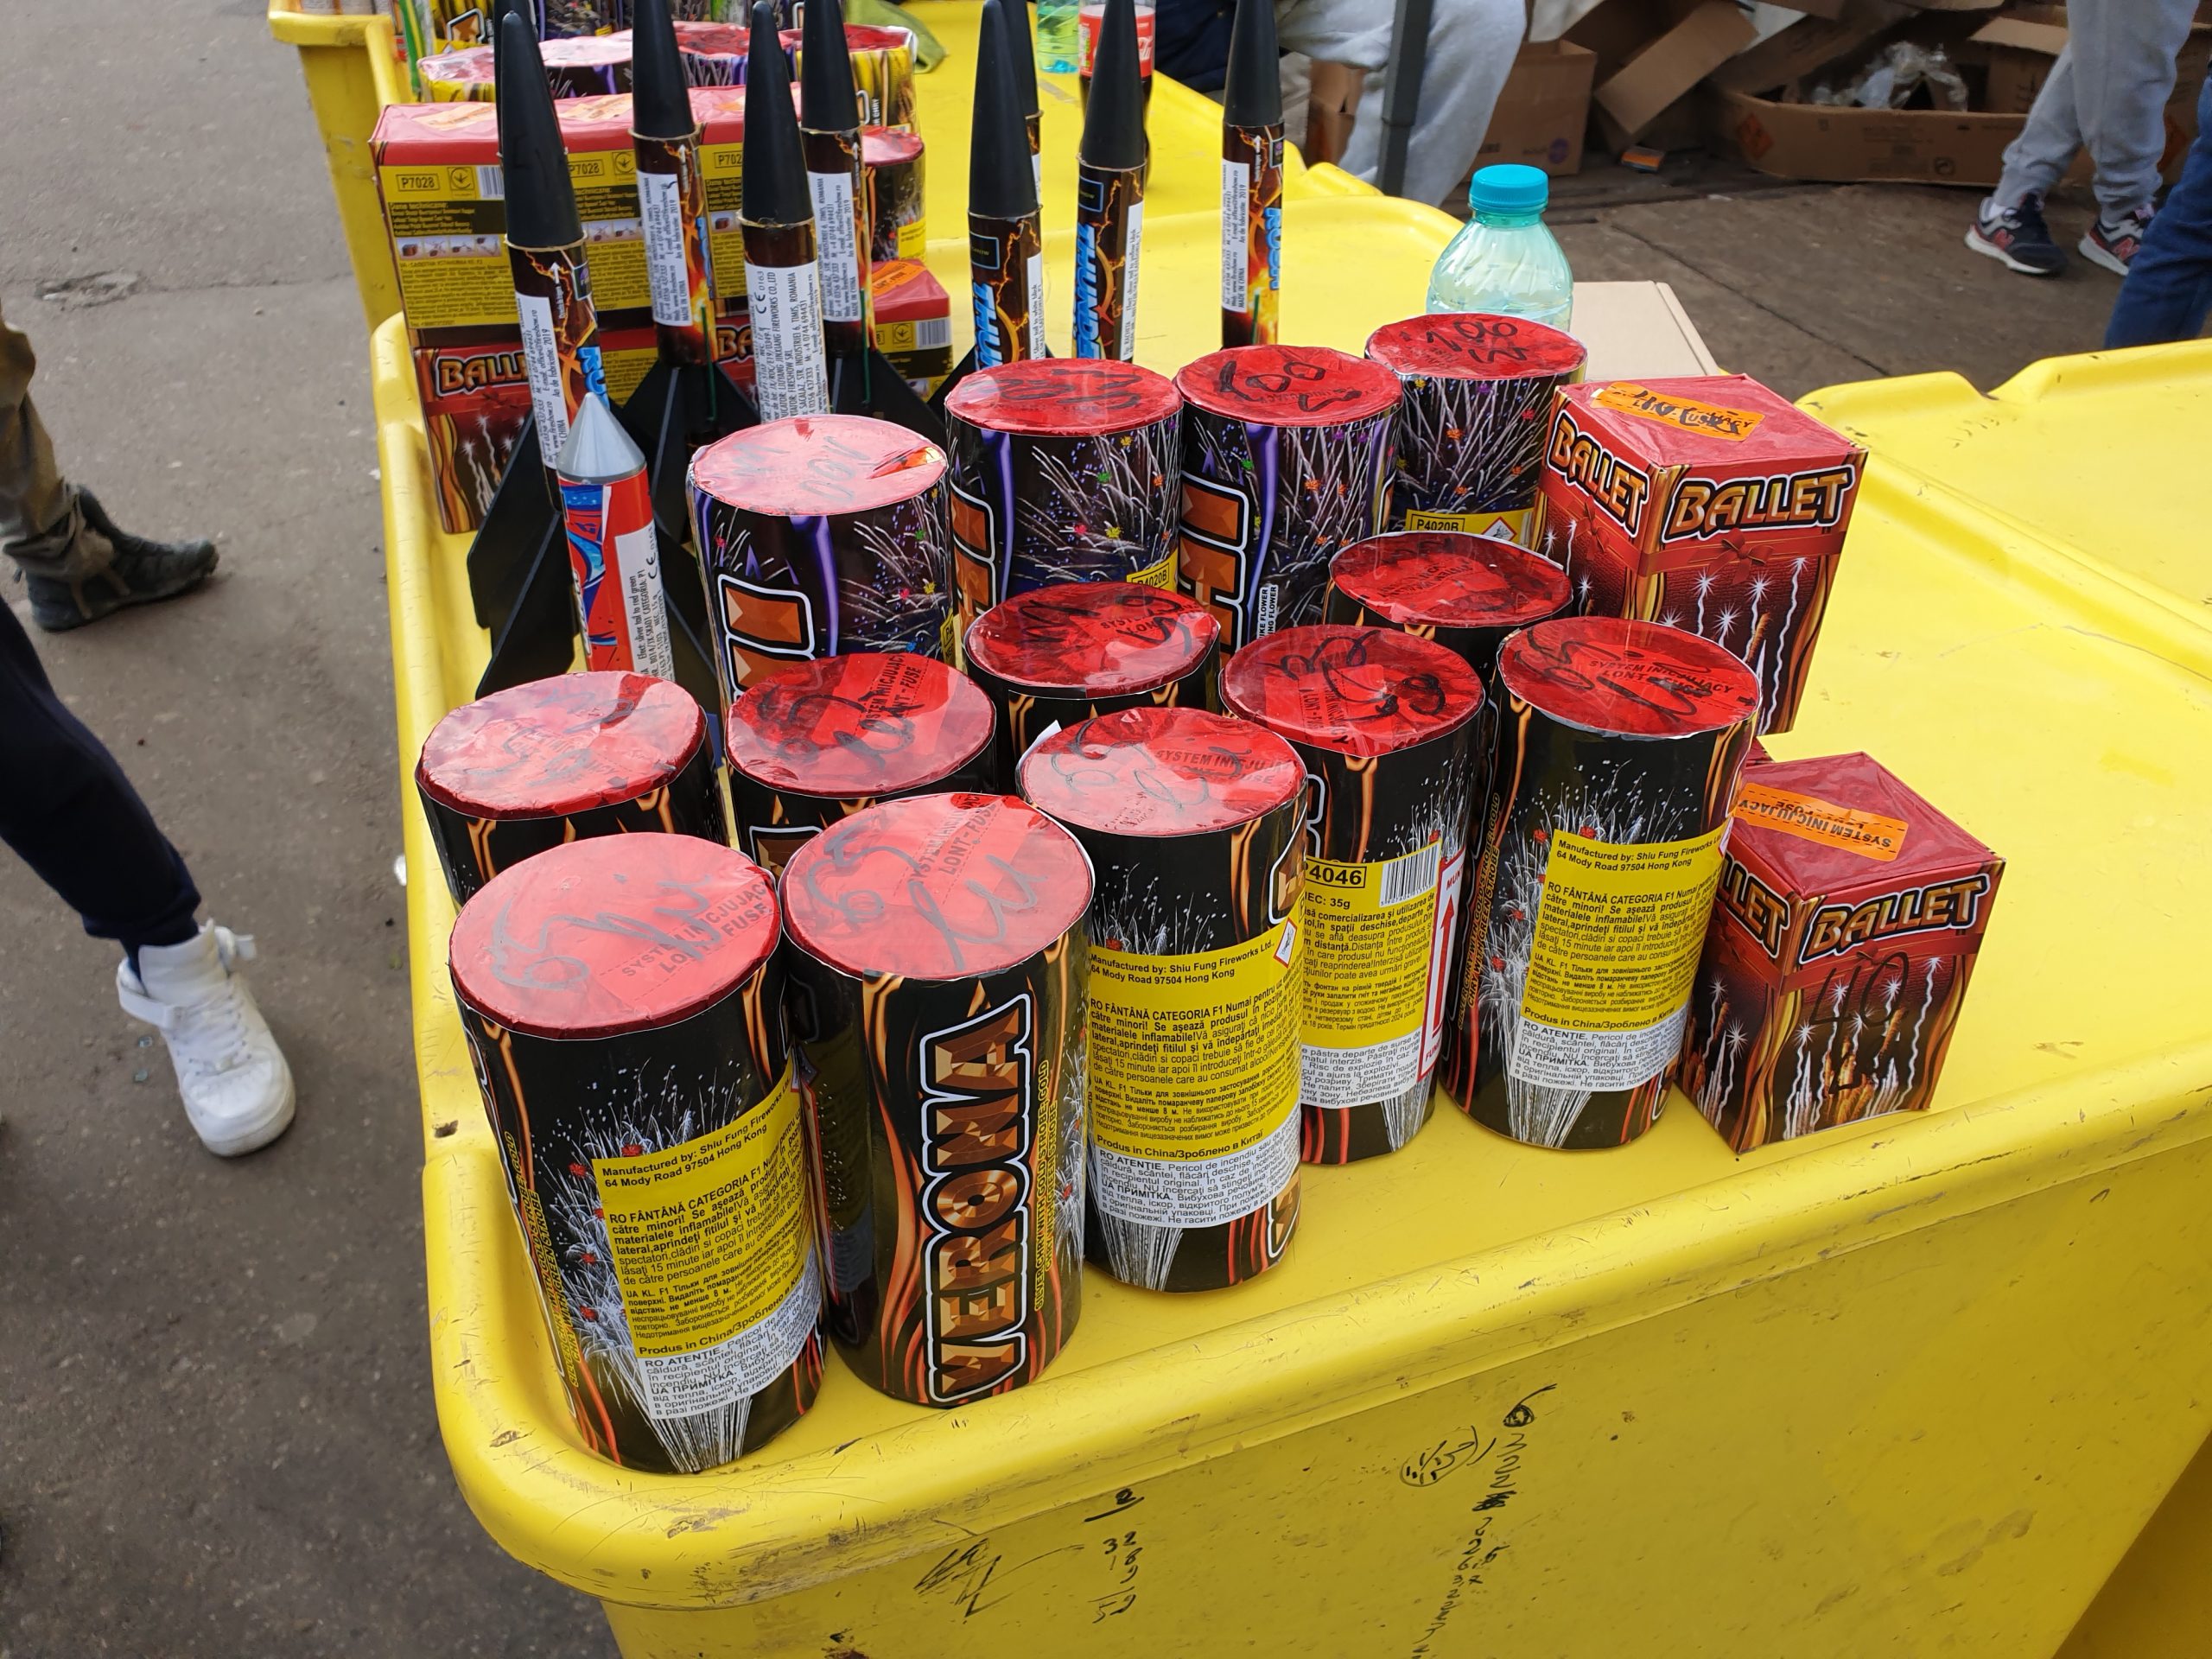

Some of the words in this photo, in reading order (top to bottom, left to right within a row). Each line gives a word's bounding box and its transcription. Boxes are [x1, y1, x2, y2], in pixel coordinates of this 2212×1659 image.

[718, 154, 742, 166] P702
[402, 178, 435, 188] P7028
[437, 352, 529, 396] BALL
[1548, 413, 1648, 536] BALLET
[1664, 468, 1853, 540] BALLET
[1416, 519, 1459, 531] P4020B
[1556, 851, 1567, 860] 64
[1569, 855, 1592, 868] Mody
[1595, 862, 1618, 871] Road
[1620, 863, 1645, 872] 97504
[1648, 861, 1669, 871] Hong
[1672, 858, 1692, 868] Kong
[1558, 840, 1618, 861] Manufactured
[1621, 853, 1633, 862] by:
[1658, 850, 1679, 860] Fung
[1681, 841, 1713, 856] Fireworks
[1305, 862, 1362, 885] 4046
[1304, 892, 1326, 905] EC:
[1331, 899, 1351, 909] 35g
[1548, 882, 1560, 893] RO
[1611, 893, 1662, 904] CATEGORIA
[1665, 892, 1674, 901] F1
[1319, 912, 1385, 922] comercializarea
[1396, 899, 1427, 914] utilizarea
[1802, 876, 1986, 961] BALLET
[1091, 953, 1149, 973] Manufactured
[1152, 965, 1166, 975] by:
[1170, 964, 1191, 973] Shiu
[1194, 960, 1217, 973] Fung
[1219, 948, 1258, 967] Fireworks
[1091, 965, 1100, 975] 64
[1103, 968, 1125, 982] Mody
[1128, 975, 1152, 984] Road
[1154, 976, 1182, 985] 97504
[1185, 973, 1209, 983] Hong
[1211, 968, 1235, 979] Kong
[1091, 999, 1103, 1009] RO
[1153, 1009, 1210, 1020] CATEGORIA
[1213, 1006, 1223, 1015] F1
[1226, 997, 1252, 1012] Numai
[1116, 1018, 1148, 1030] minori!
[1154, 1022, 1166, 1032] Se
[1211, 1010, 1248, 1028] produsul
[1038, 1060, 1049, 1100] GOLD
[603, 1154, 677, 1177] Manufactured
[681, 1151, 696, 1162] by:
[700, 1141, 721, 1154] Shiu
[725, 1125, 748, 1141] Fung
[751, 1094, 781, 1128] Fireworks
[1047, 1100, 1057, 1155] STROBE
[1097, 1135, 1130, 1153] Produs
[605, 1179, 618, 1187] 64
[621, 1173, 651, 1186] Mody
[655, 1168, 682, 1182] Road
[684, 1154, 715, 1172] 97504
[717, 1141, 741, 1159] Hong
[744, 1125, 767, 1144] Kong
[1037, 1160, 1047, 1196] GOLD
[1046, 1157, 1056, 1201] GREEN
[610, 1214, 626, 1224] RO
[689, 1176, 749, 1209] CATEGORIA
[752, 1166, 761, 1179] F1
[929, 1000, 1024, 1397] VERONA
[1035, 1197, 1046, 1231] WITH
[1035, 1235, 1046, 1268] CHRY
[1045, 1236, 1053, 1271] CHRY
[1034, 1268, 1045, 1312] SILVER
[639, 1344, 682, 1354] Produs
[685, 1343, 696, 1351] in
